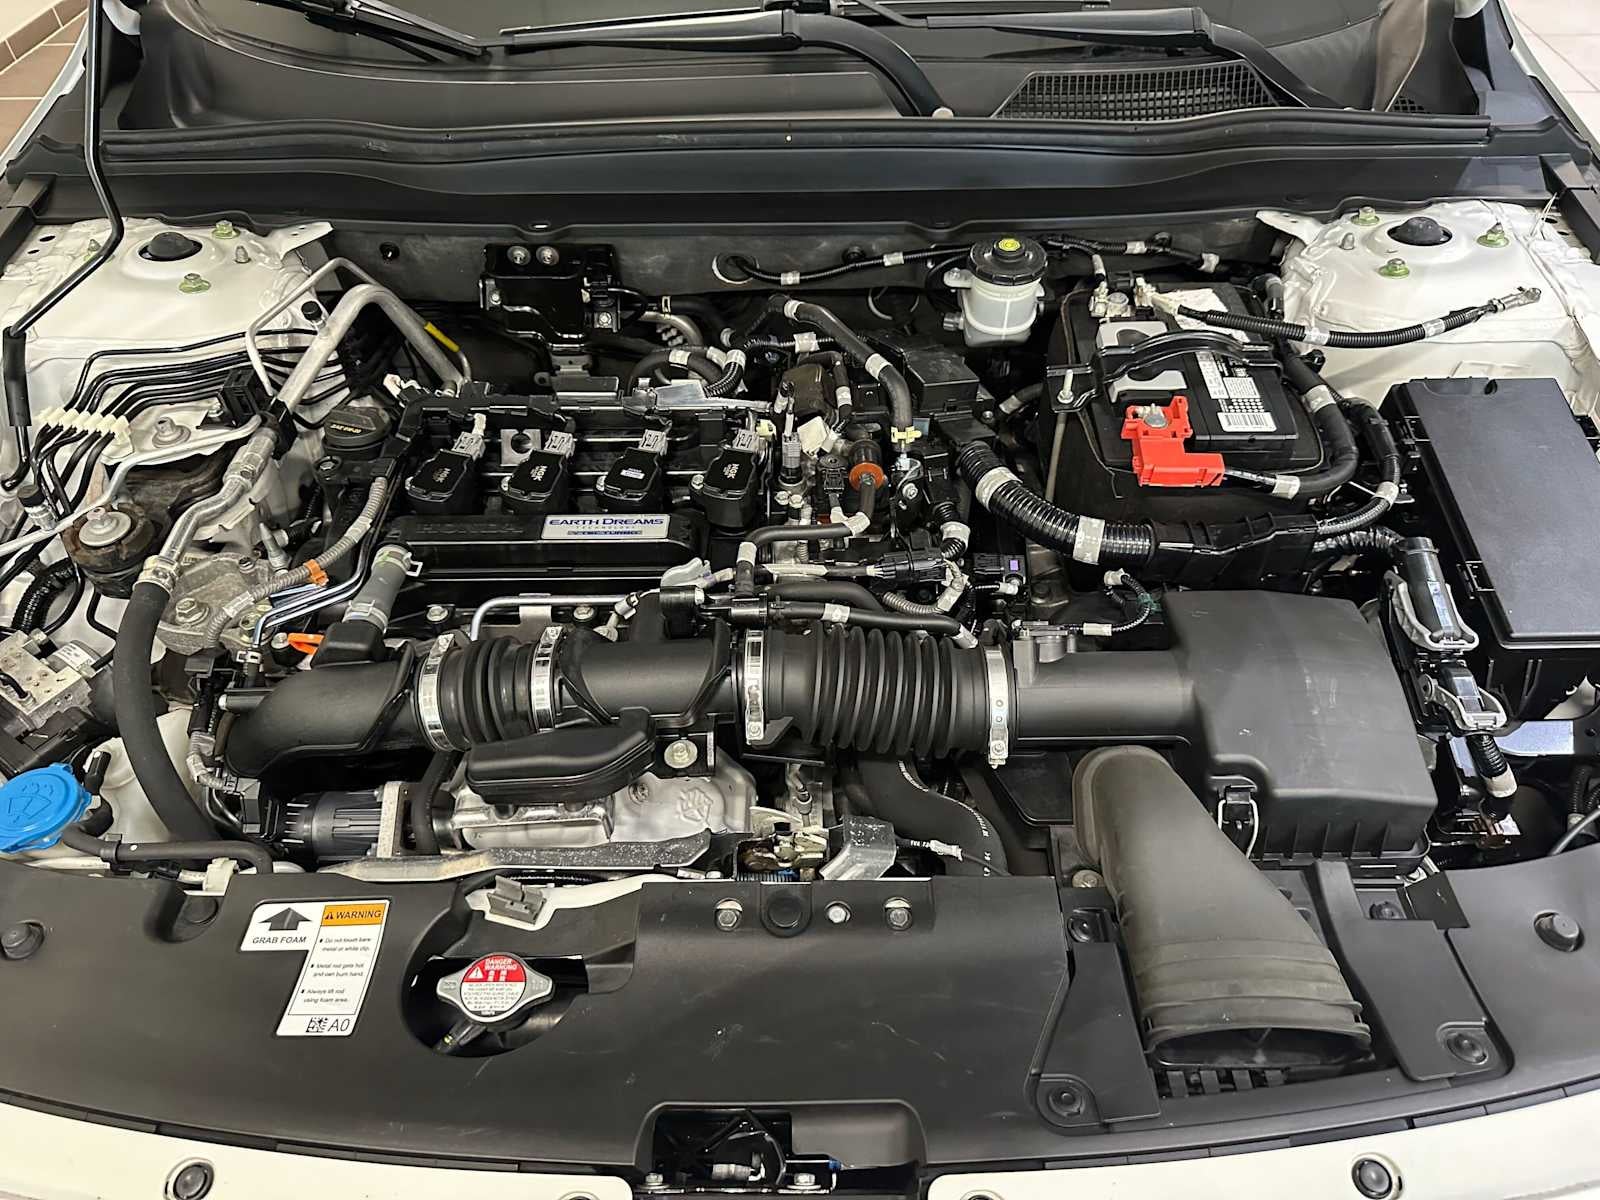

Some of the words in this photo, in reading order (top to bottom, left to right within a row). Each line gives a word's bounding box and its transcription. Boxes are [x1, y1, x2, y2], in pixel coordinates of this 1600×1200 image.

[727, 463, 740, 479] NGK
[549, 518, 599, 526] EARTH
[602, 517, 664, 526] DREAMS
[336, 910, 381, 919] WARNING
[252, 936, 278, 944] GRAB
[279, 935, 307, 944] FOAM
[328, 1018, 350, 1031] A0
